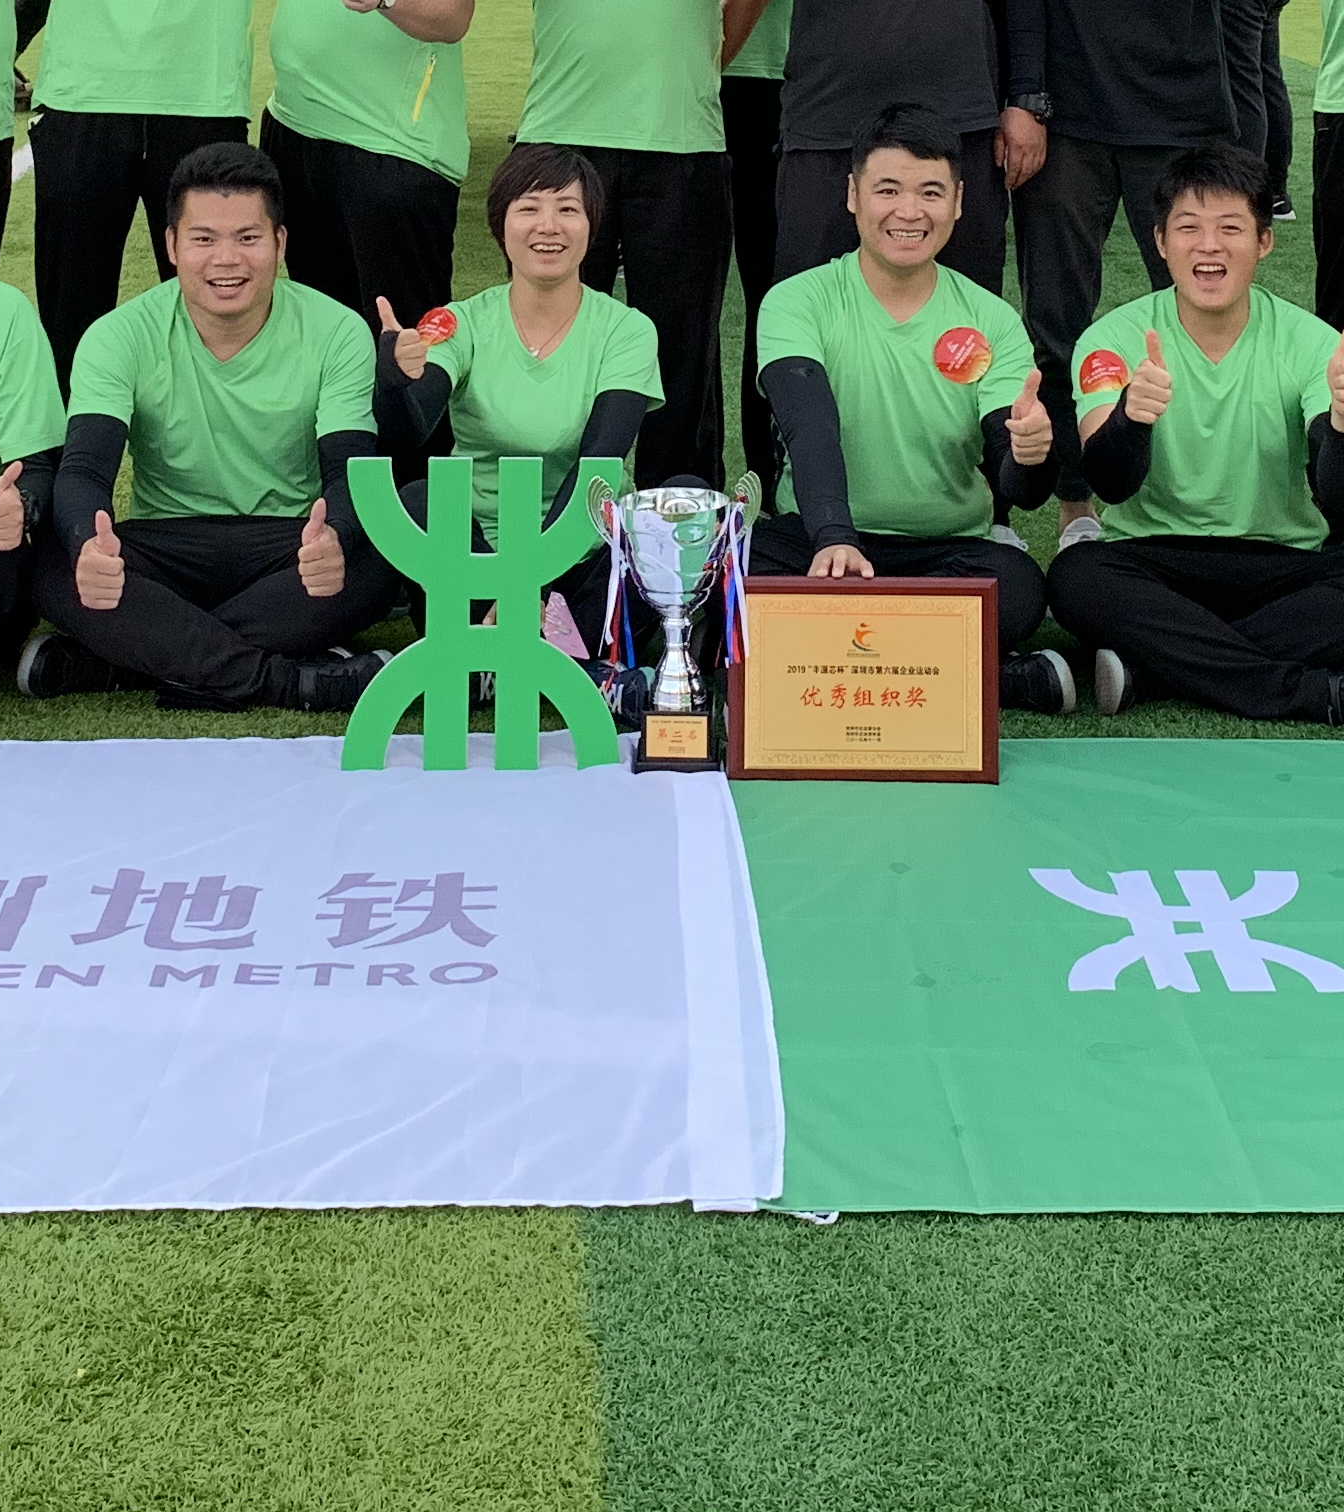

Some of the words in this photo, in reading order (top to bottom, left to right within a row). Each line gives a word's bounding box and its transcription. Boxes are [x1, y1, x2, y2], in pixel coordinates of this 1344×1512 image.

[787, 665, 806, 674] 2019
[800, 683, 927, 709] 优秀组织奖
[148, 959, 500, 989] METRO
